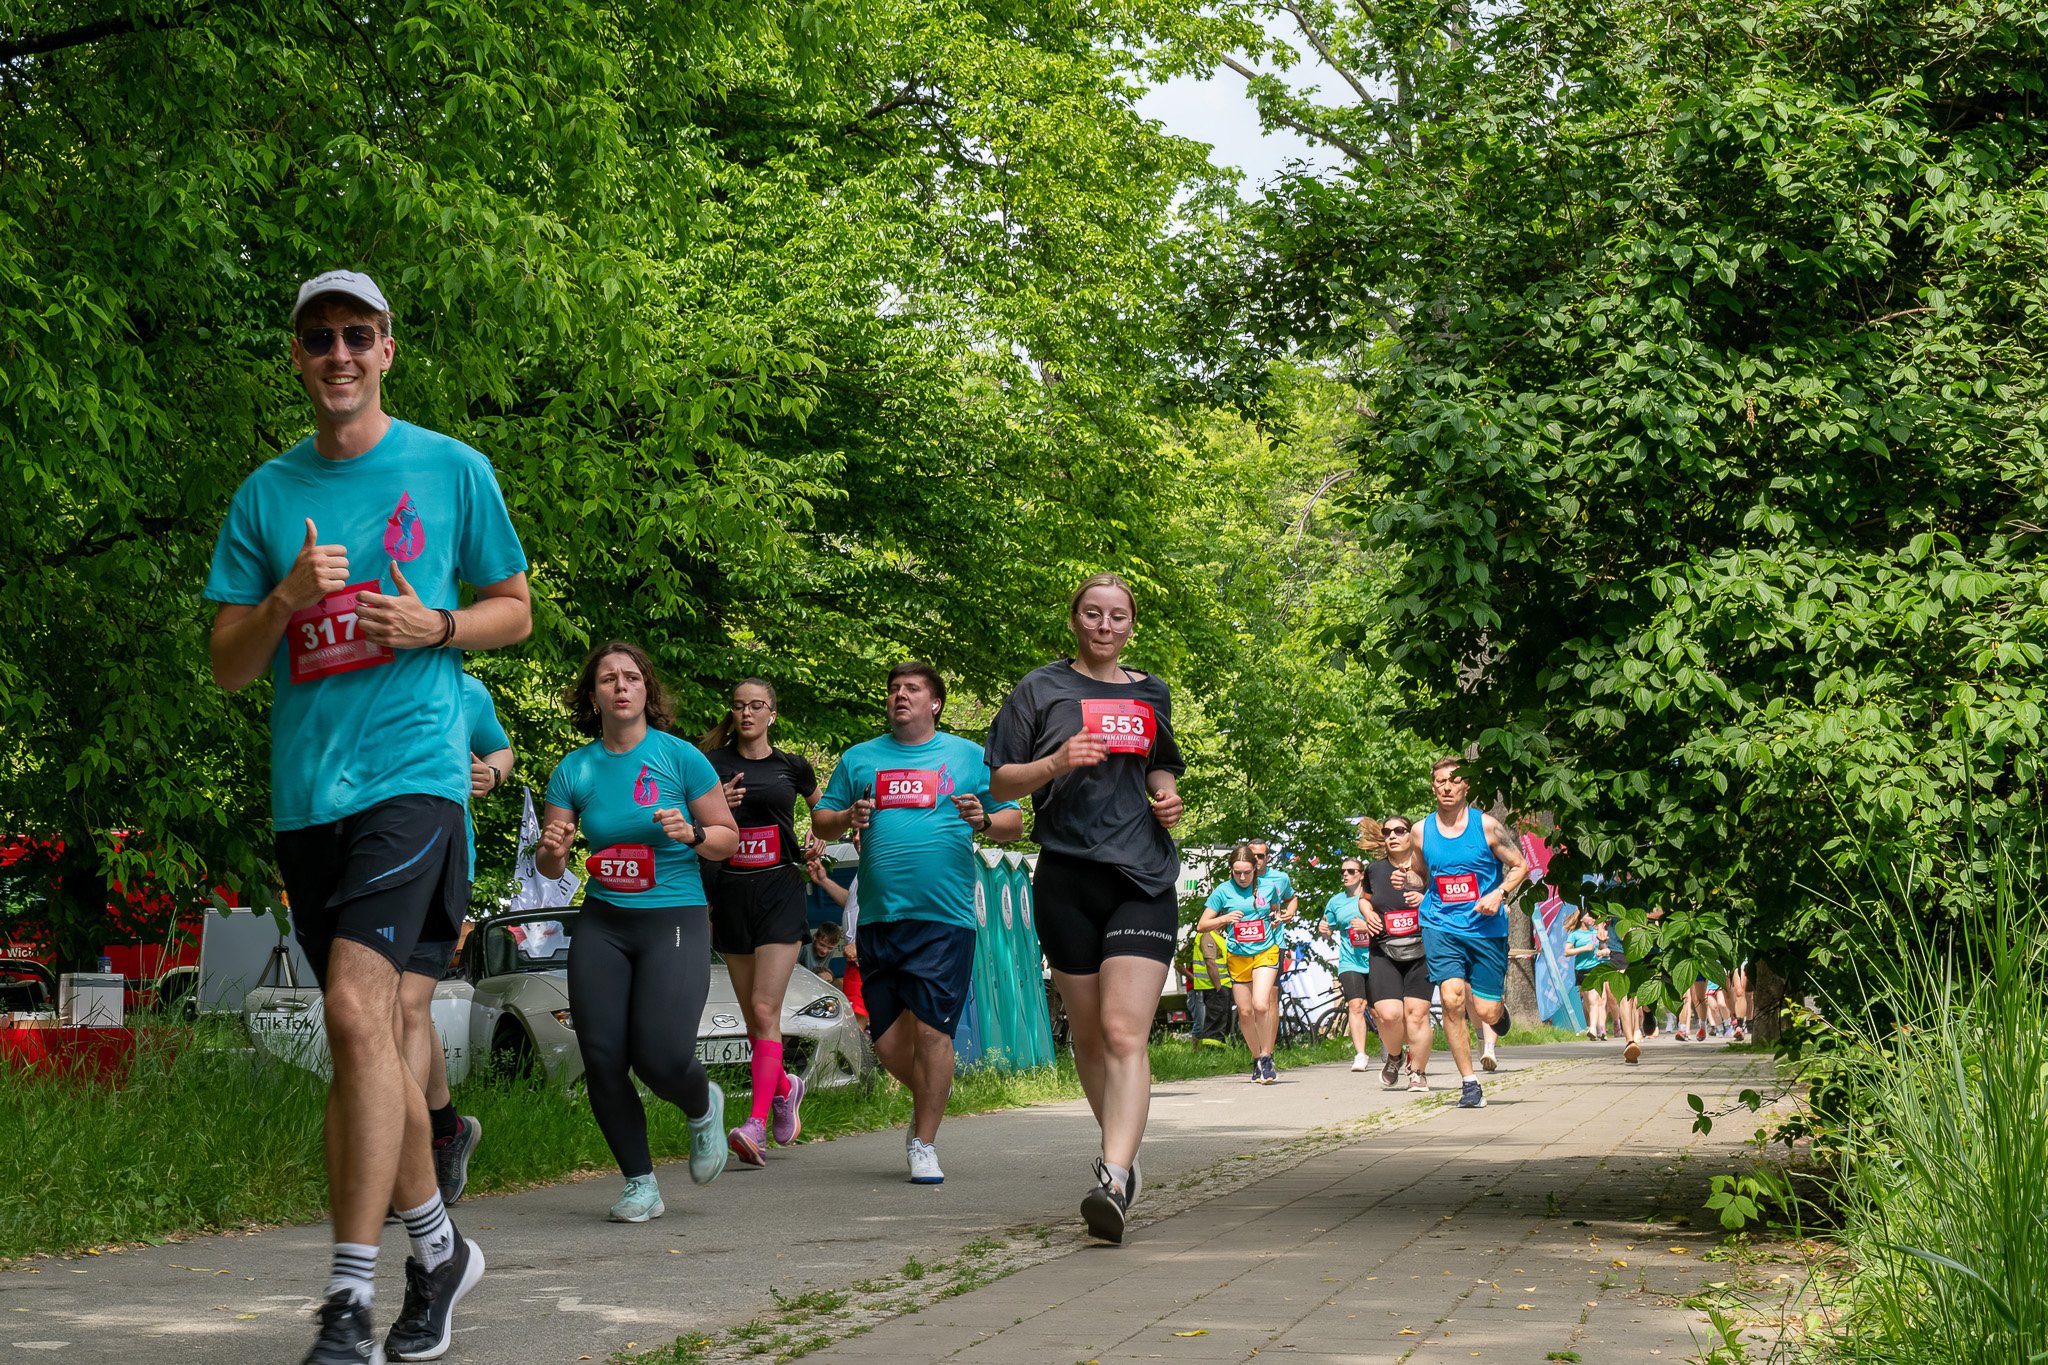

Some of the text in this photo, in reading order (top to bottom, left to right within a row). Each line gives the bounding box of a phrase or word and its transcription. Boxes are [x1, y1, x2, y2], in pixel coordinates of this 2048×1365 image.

[301, 612, 358, 650] 317
[1101, 715, 1145, 735] 553
[888, 780, 924, 795] 503
[738, 840, 767, 854] 171
[600, 860, 639, 877] 578
[1445, 882, 1470, 895] 560
[1393, 917, 1414, 929] 638
[1239, 926, 1259, 936] 343
[256, 1016, 314, 1031] TikTok
